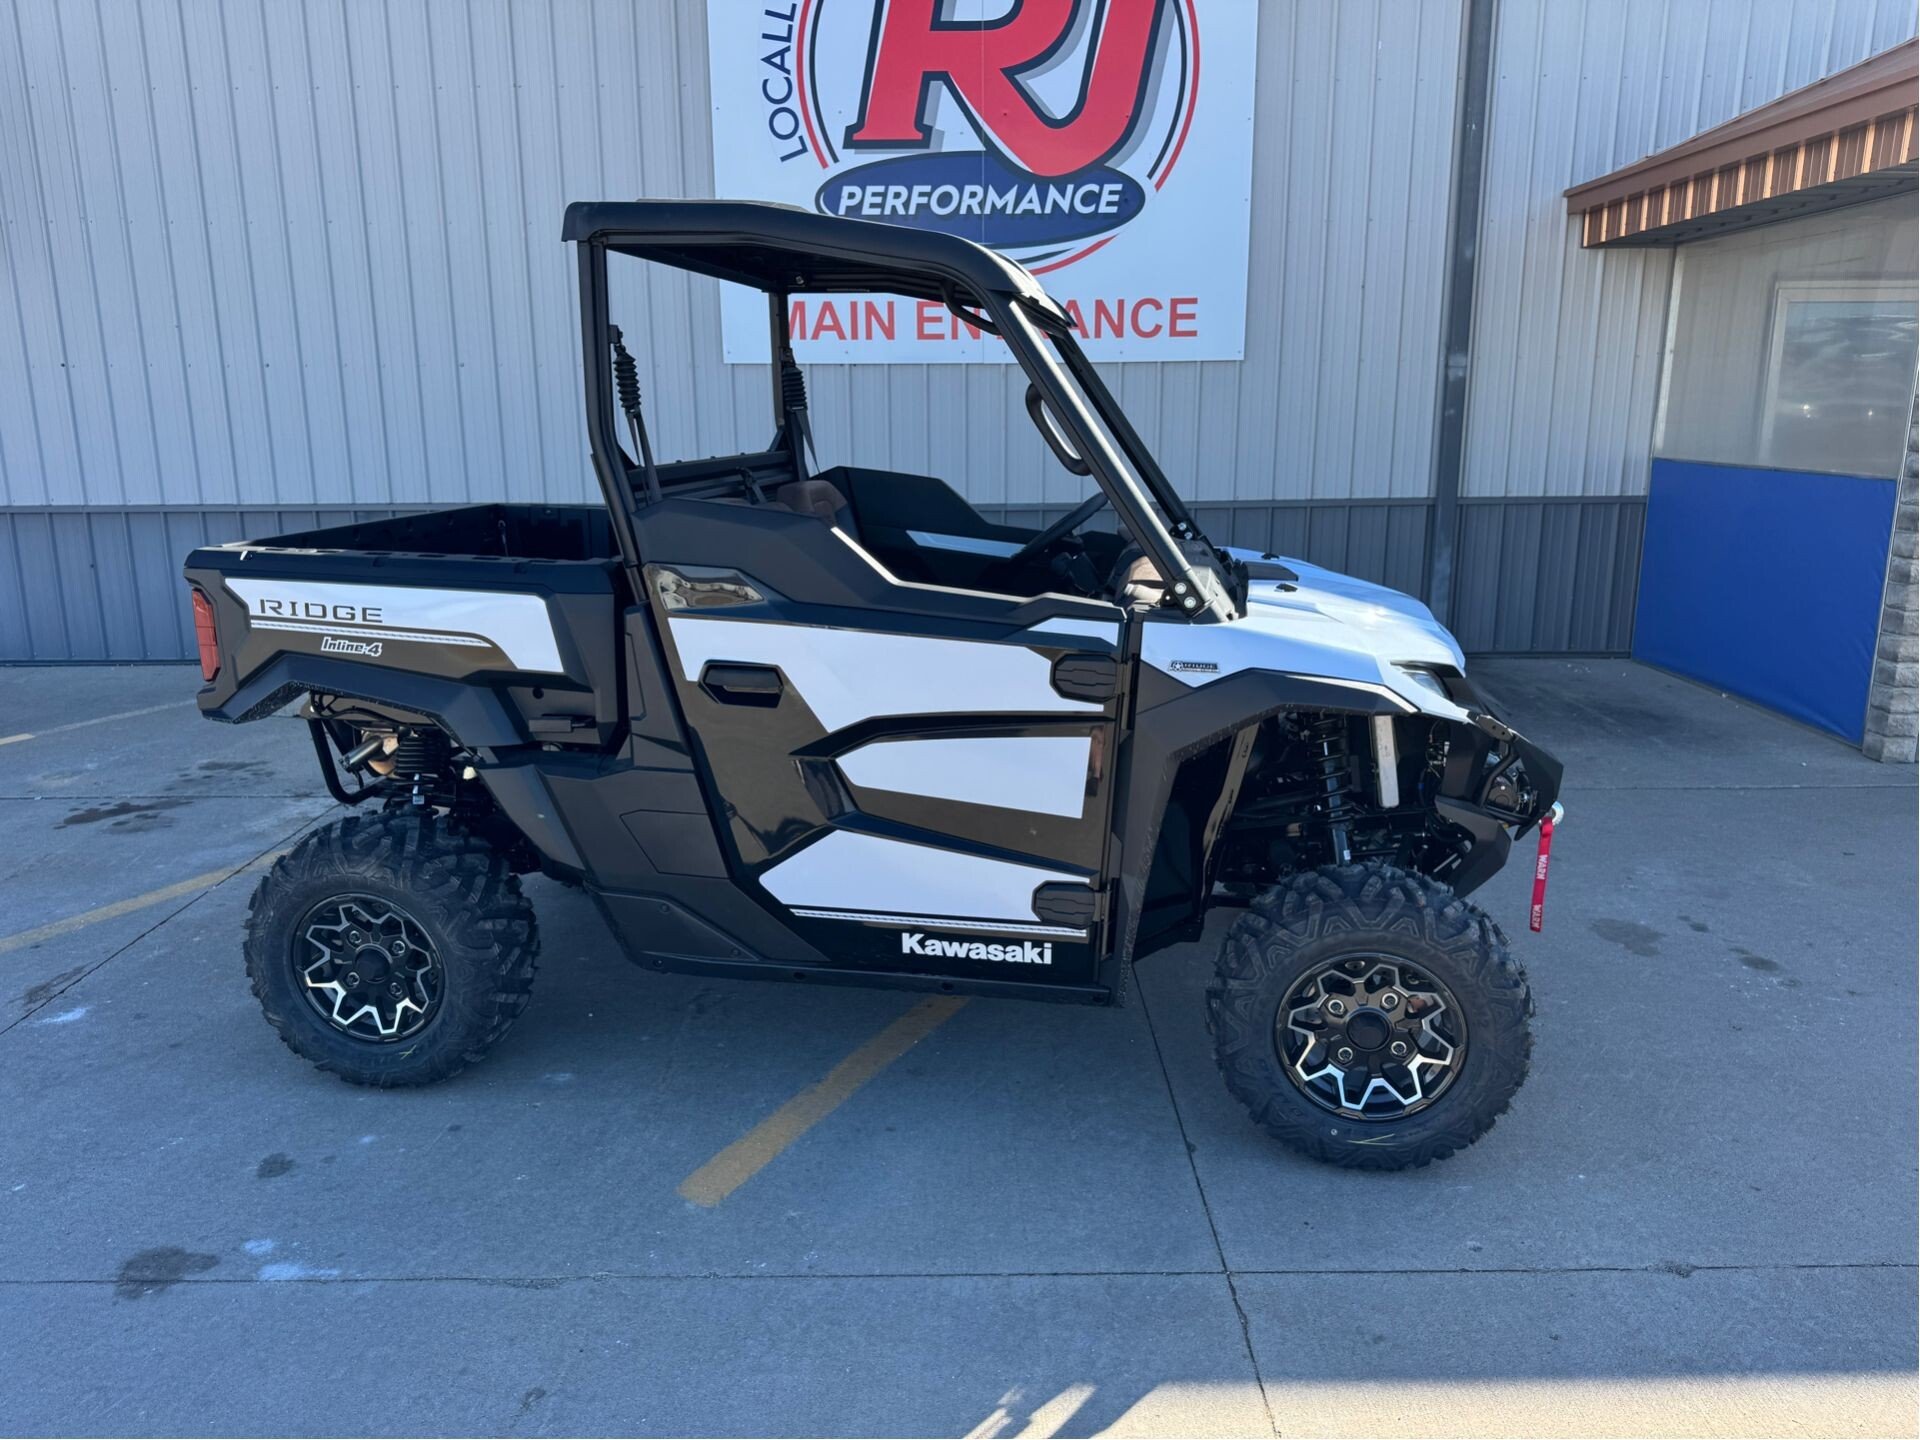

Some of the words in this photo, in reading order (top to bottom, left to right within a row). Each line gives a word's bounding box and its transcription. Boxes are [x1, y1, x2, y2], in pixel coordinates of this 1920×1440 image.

[843, 0, 1162, 180] RJ
[838, 183, 1123, 216] PERFORMANCE
[915, 297, 1198, 341] ENANCE
[260, 599, 383, 623] RIDGE
[320, 636, 382, 657] Inline-4
[1536, 854, 1548, 879] WARN
[901, 931, 1053, 965] Kawasaki
